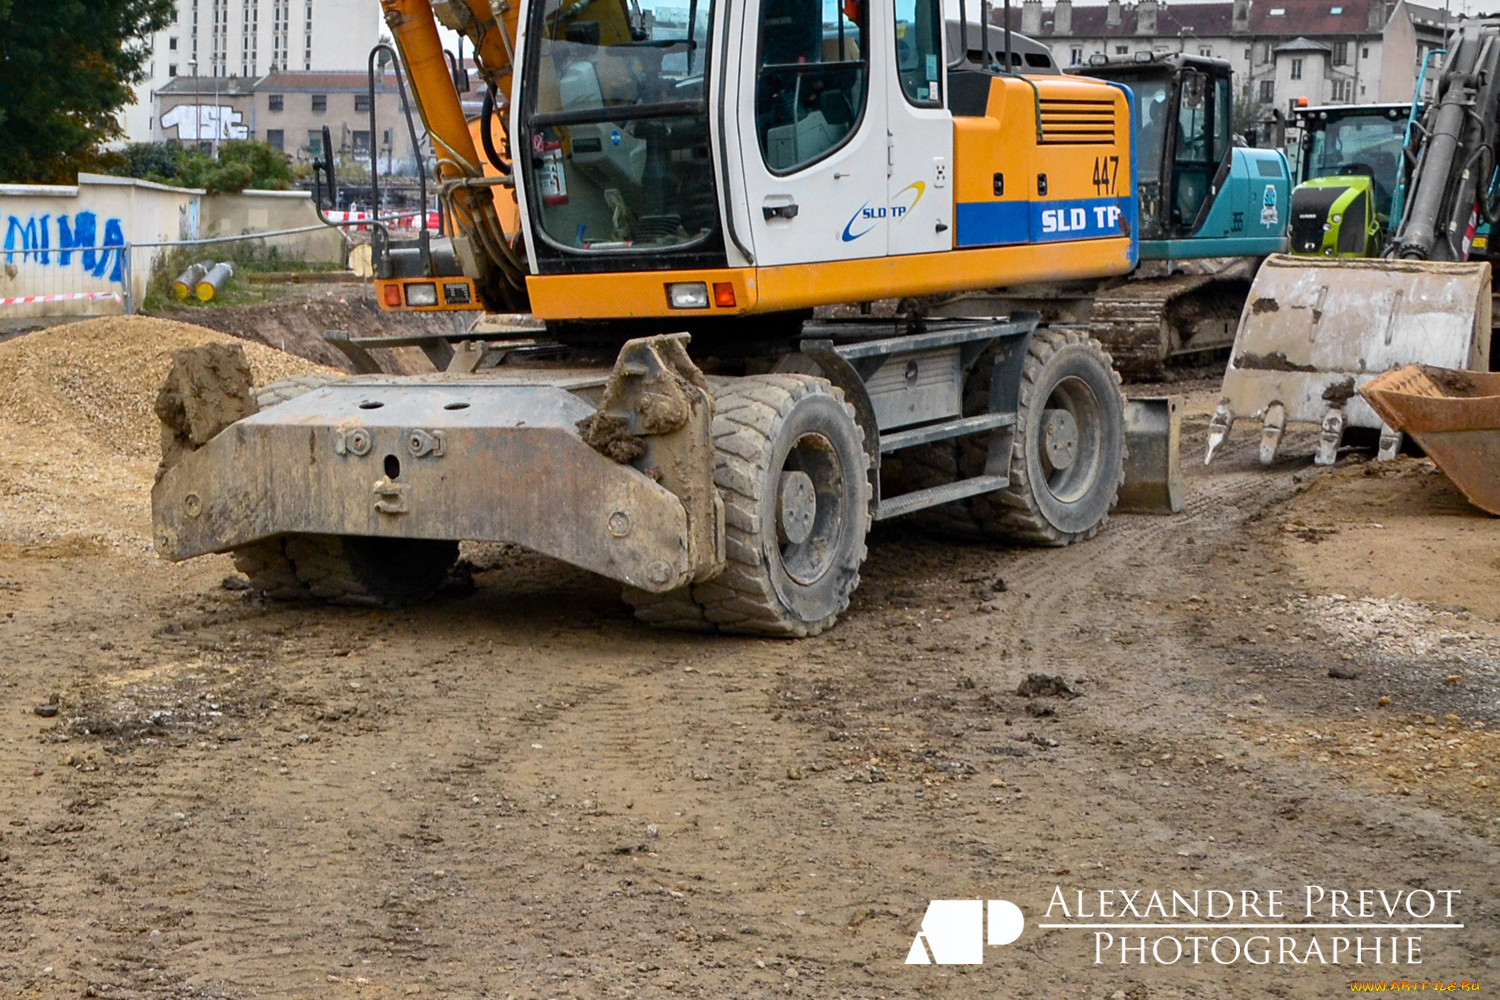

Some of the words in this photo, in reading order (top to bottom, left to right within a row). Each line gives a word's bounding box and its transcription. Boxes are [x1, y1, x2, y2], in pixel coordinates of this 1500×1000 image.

[1092, 155, 1119, 196] 447
[862, 207, 887, 219] SLD
[890, 206, 907, 217] TP
[1041, 207, 1087, 233] SLD
[1092, 205, 1122, 229] TP
